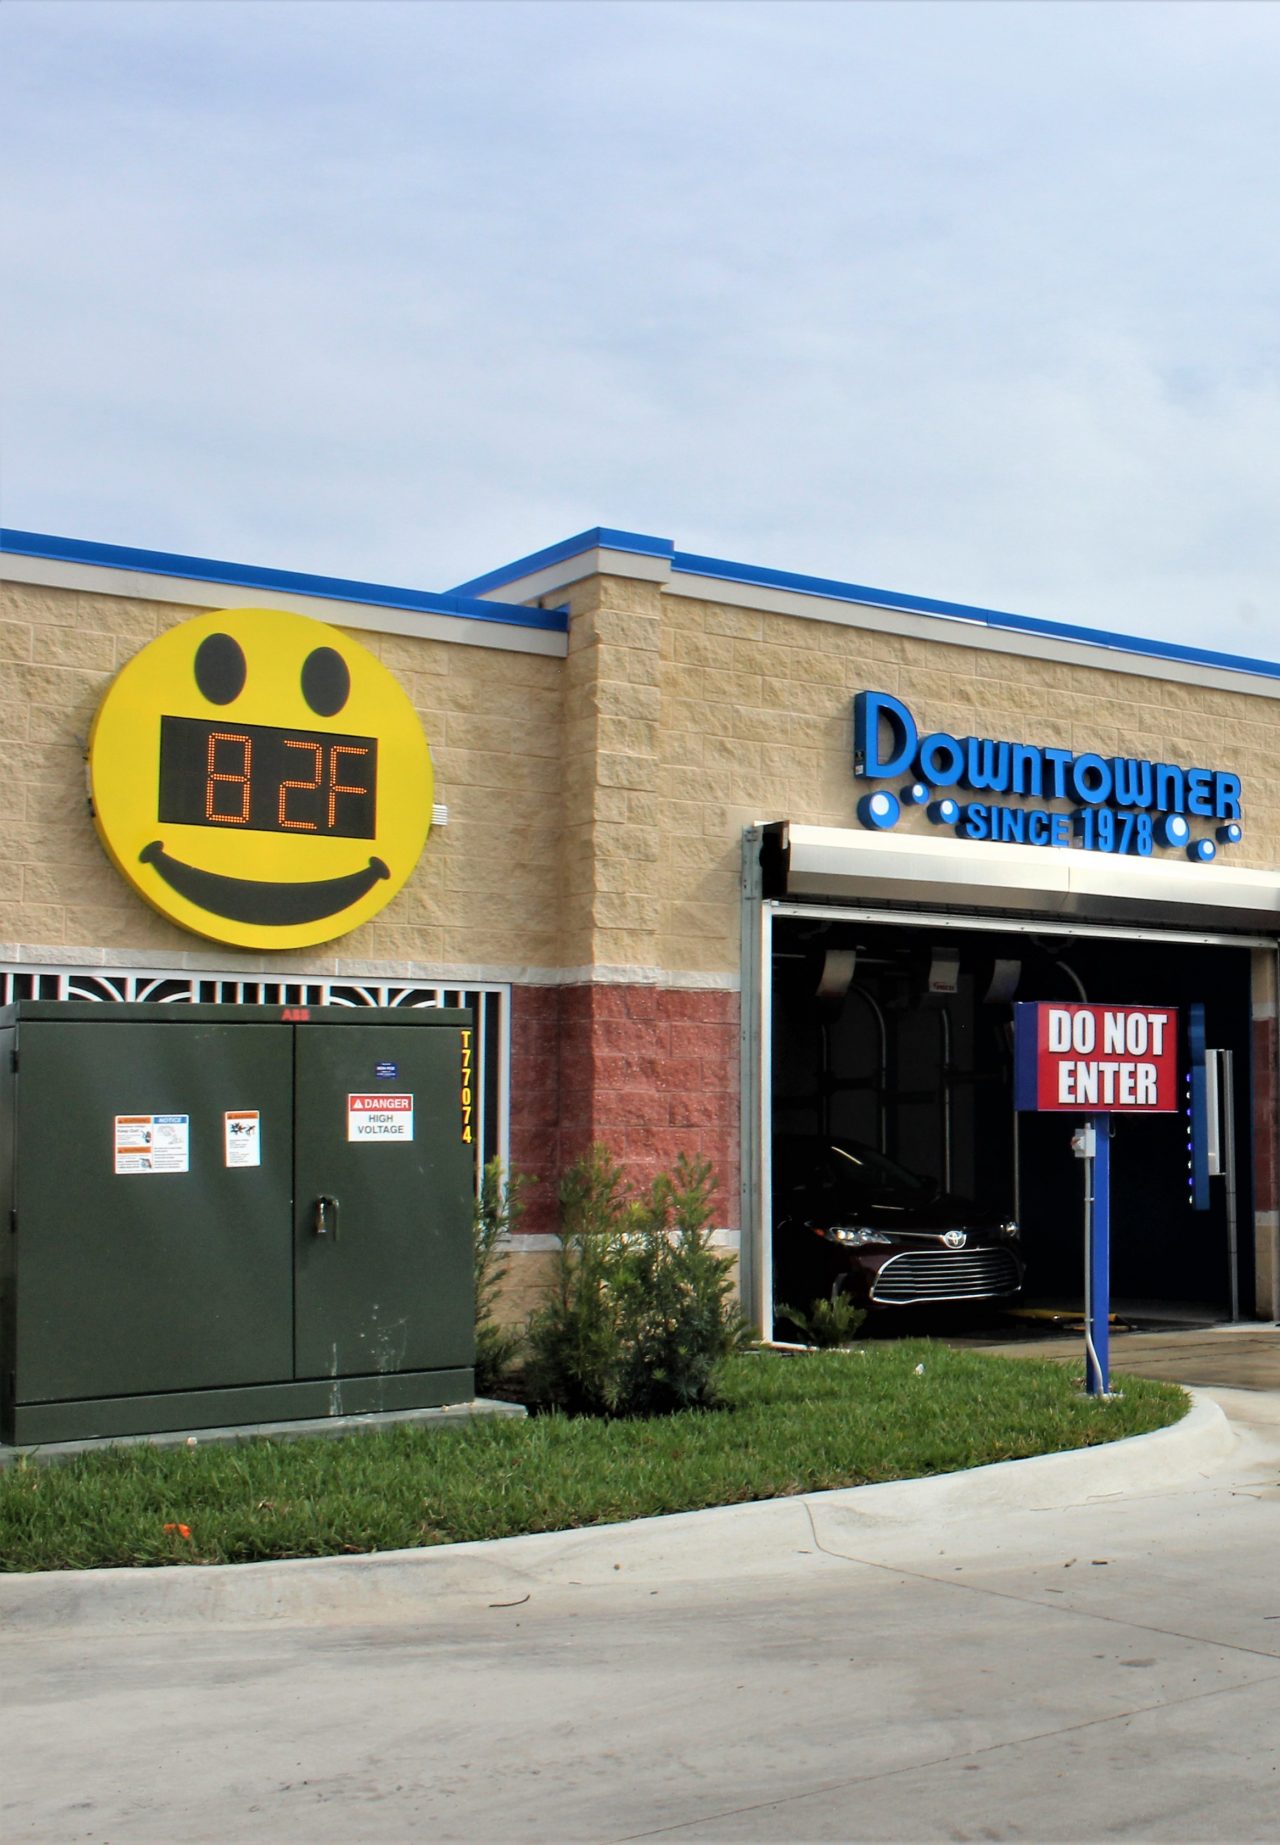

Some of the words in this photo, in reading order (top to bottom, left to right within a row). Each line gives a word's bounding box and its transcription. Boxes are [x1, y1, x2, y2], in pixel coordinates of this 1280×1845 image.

[961, 802, 1071, 848] SINCE
[1077, 807, 1153, 857] 1978
[1048, 1009, 1096, 1055] DO
[1104, 1011, 1168, 1056] NOT
[364, 1098, 409, 1109] DANGER
[461, 1031, 473, 1144] T77074
[1058, 1061, 1157, 1105] ENTER
[358, 1125, 405, 1134] VOLTAGE
[368, 1114, 394, 1123] HIGH
